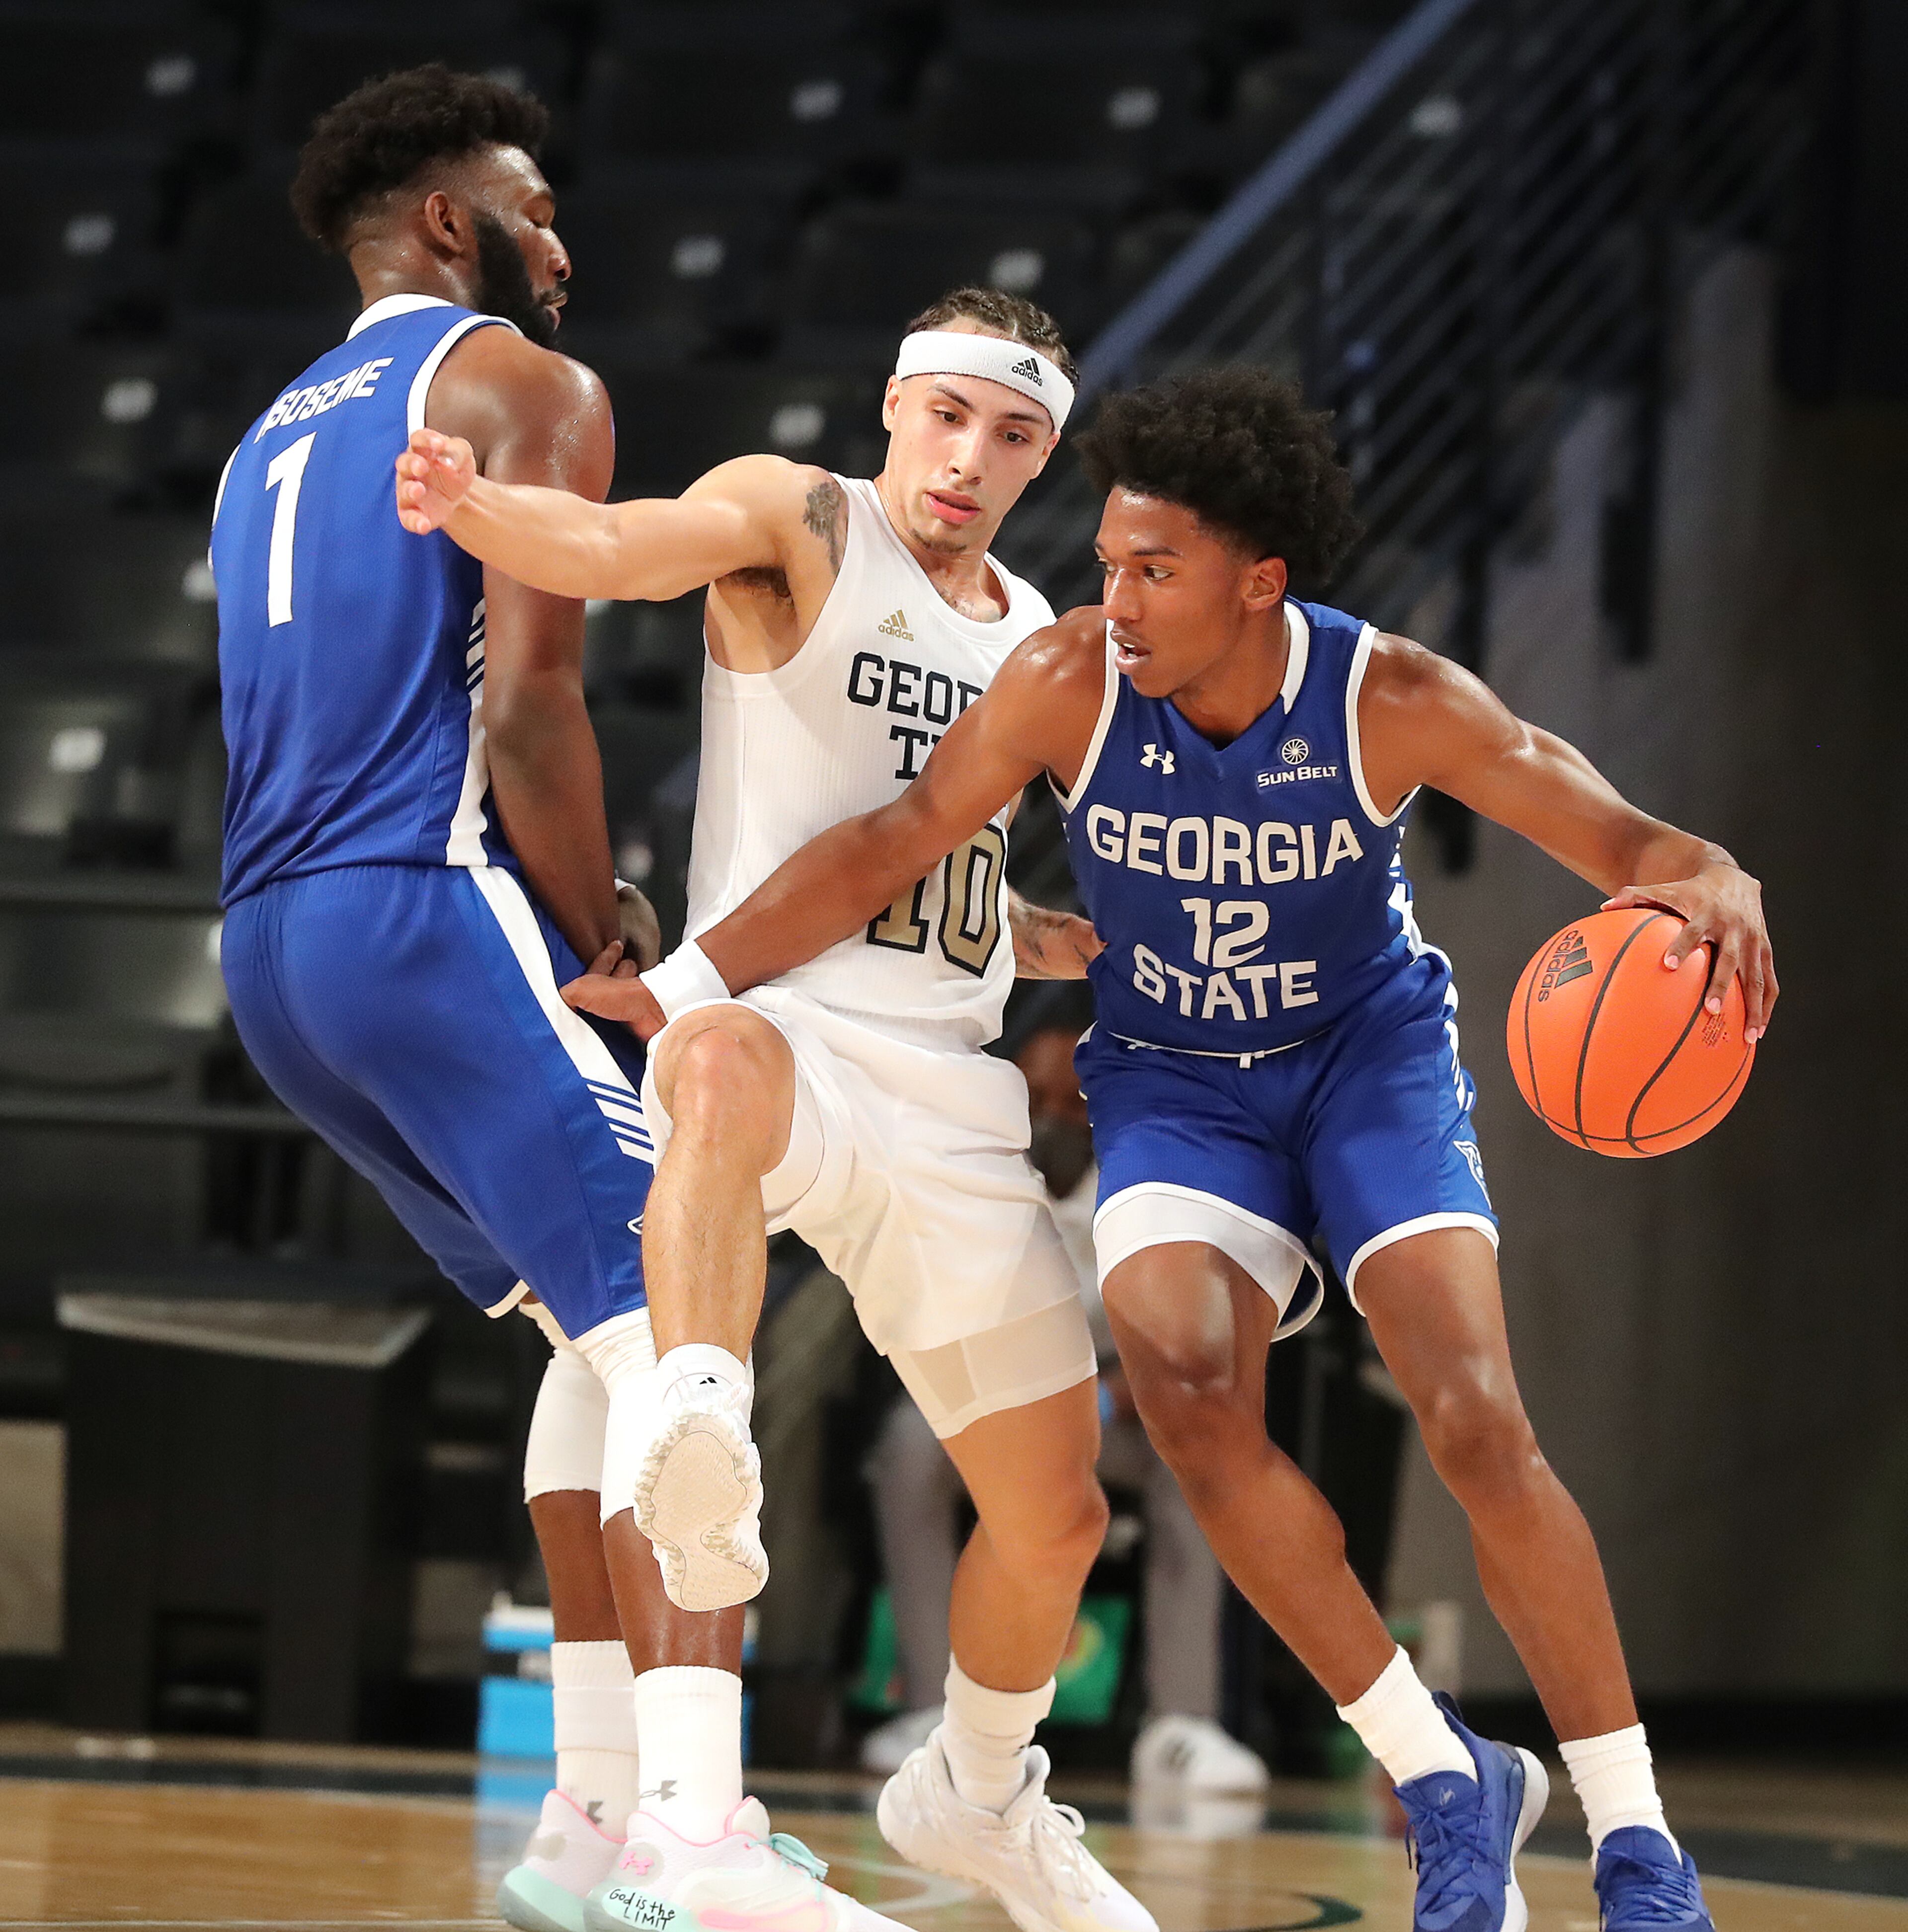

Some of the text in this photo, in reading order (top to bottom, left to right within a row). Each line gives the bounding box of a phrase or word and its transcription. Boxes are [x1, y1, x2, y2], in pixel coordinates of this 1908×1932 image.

[1012, 366, 1042, 386] adidas
[265, 431, 317, 628] 1
[878, 623, 914, 642] adidas
[889, 725, 942, 780] T
[1087, 803, 1364, 885] GEORGIA
[1180, 897, 1271, 969] 12
[1132, 943, 1319, 1021] STATE
[1538, 930, 1579, 1002] adidas
[609, 1889, 676, 1919] God is the
[624, 1907, 670, 1931] LIMIT
